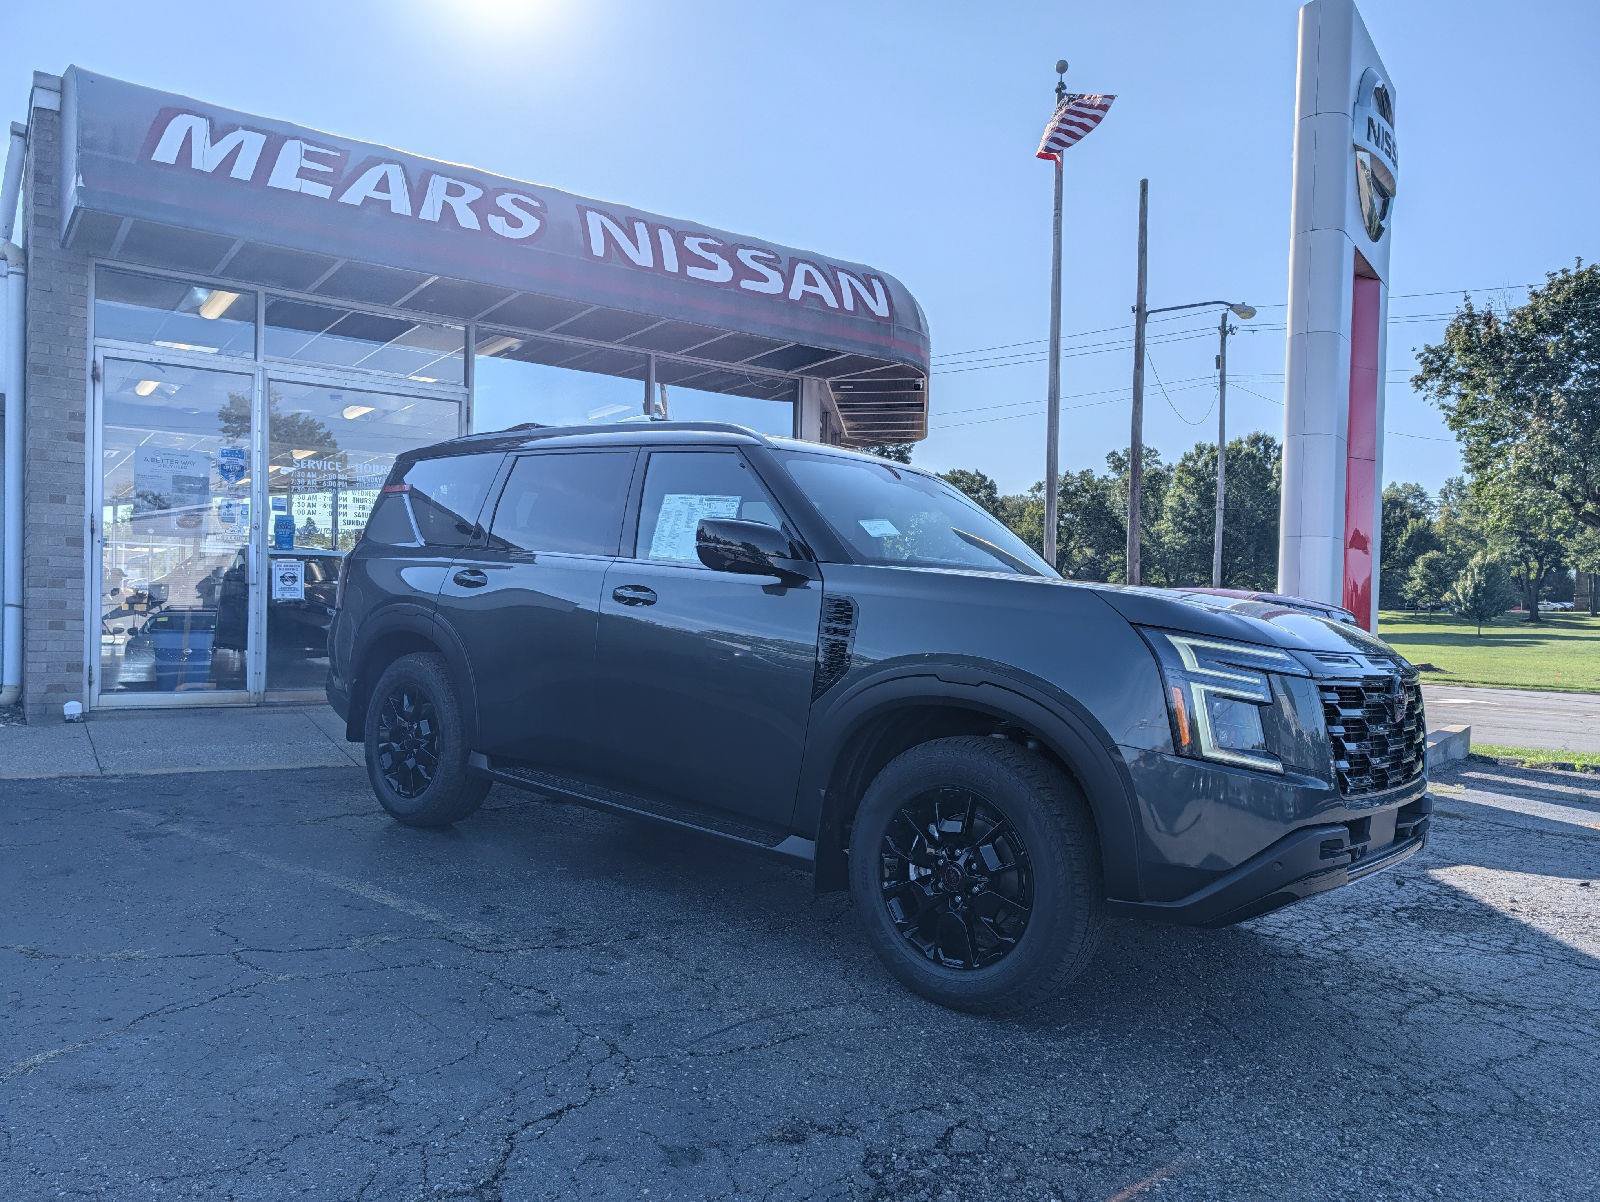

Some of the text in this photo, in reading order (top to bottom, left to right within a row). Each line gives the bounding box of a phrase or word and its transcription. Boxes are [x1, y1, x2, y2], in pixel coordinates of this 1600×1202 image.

[1367, 115, 1398, 170] NISS
[151, 112, 890, 318] MEARS NISSAN
[292, 458, 342, 472] SERVICE
[352, 489, 376, 497] WEDNES
[338, 503, 348, 511] PM
